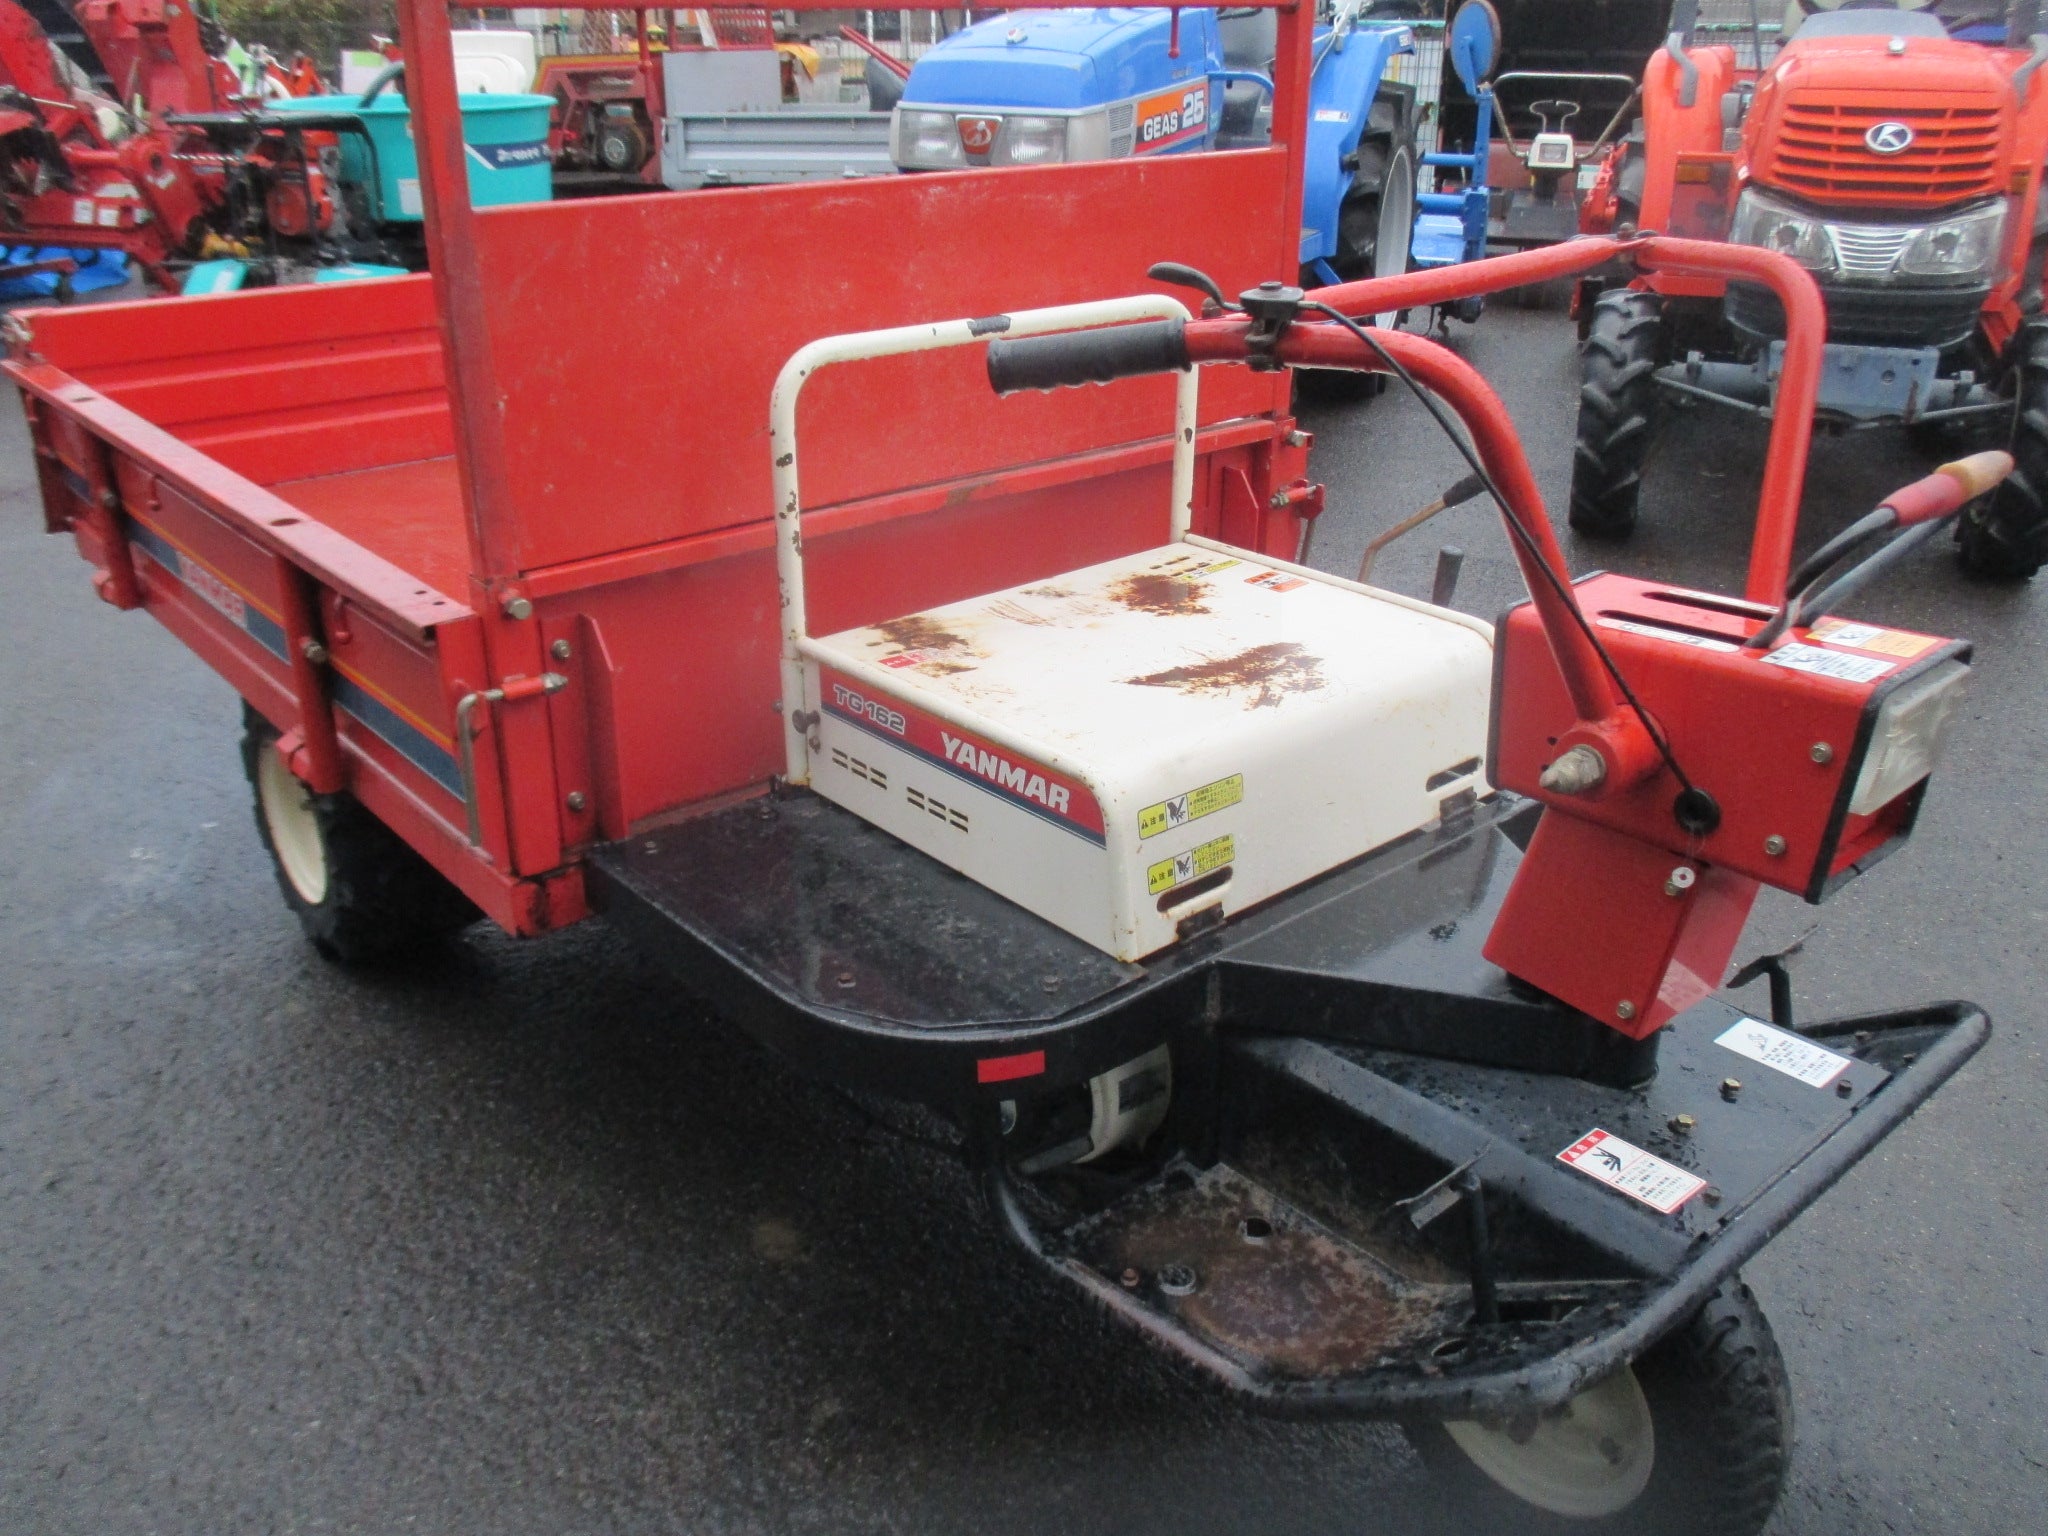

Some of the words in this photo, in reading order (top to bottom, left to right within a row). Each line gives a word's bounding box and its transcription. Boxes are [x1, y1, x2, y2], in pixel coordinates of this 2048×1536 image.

[1143, 111, 1178, 141] GEAS
[1182, 90, 1204, 128] 25
[940, 732, 1069, 814] YANMAR
